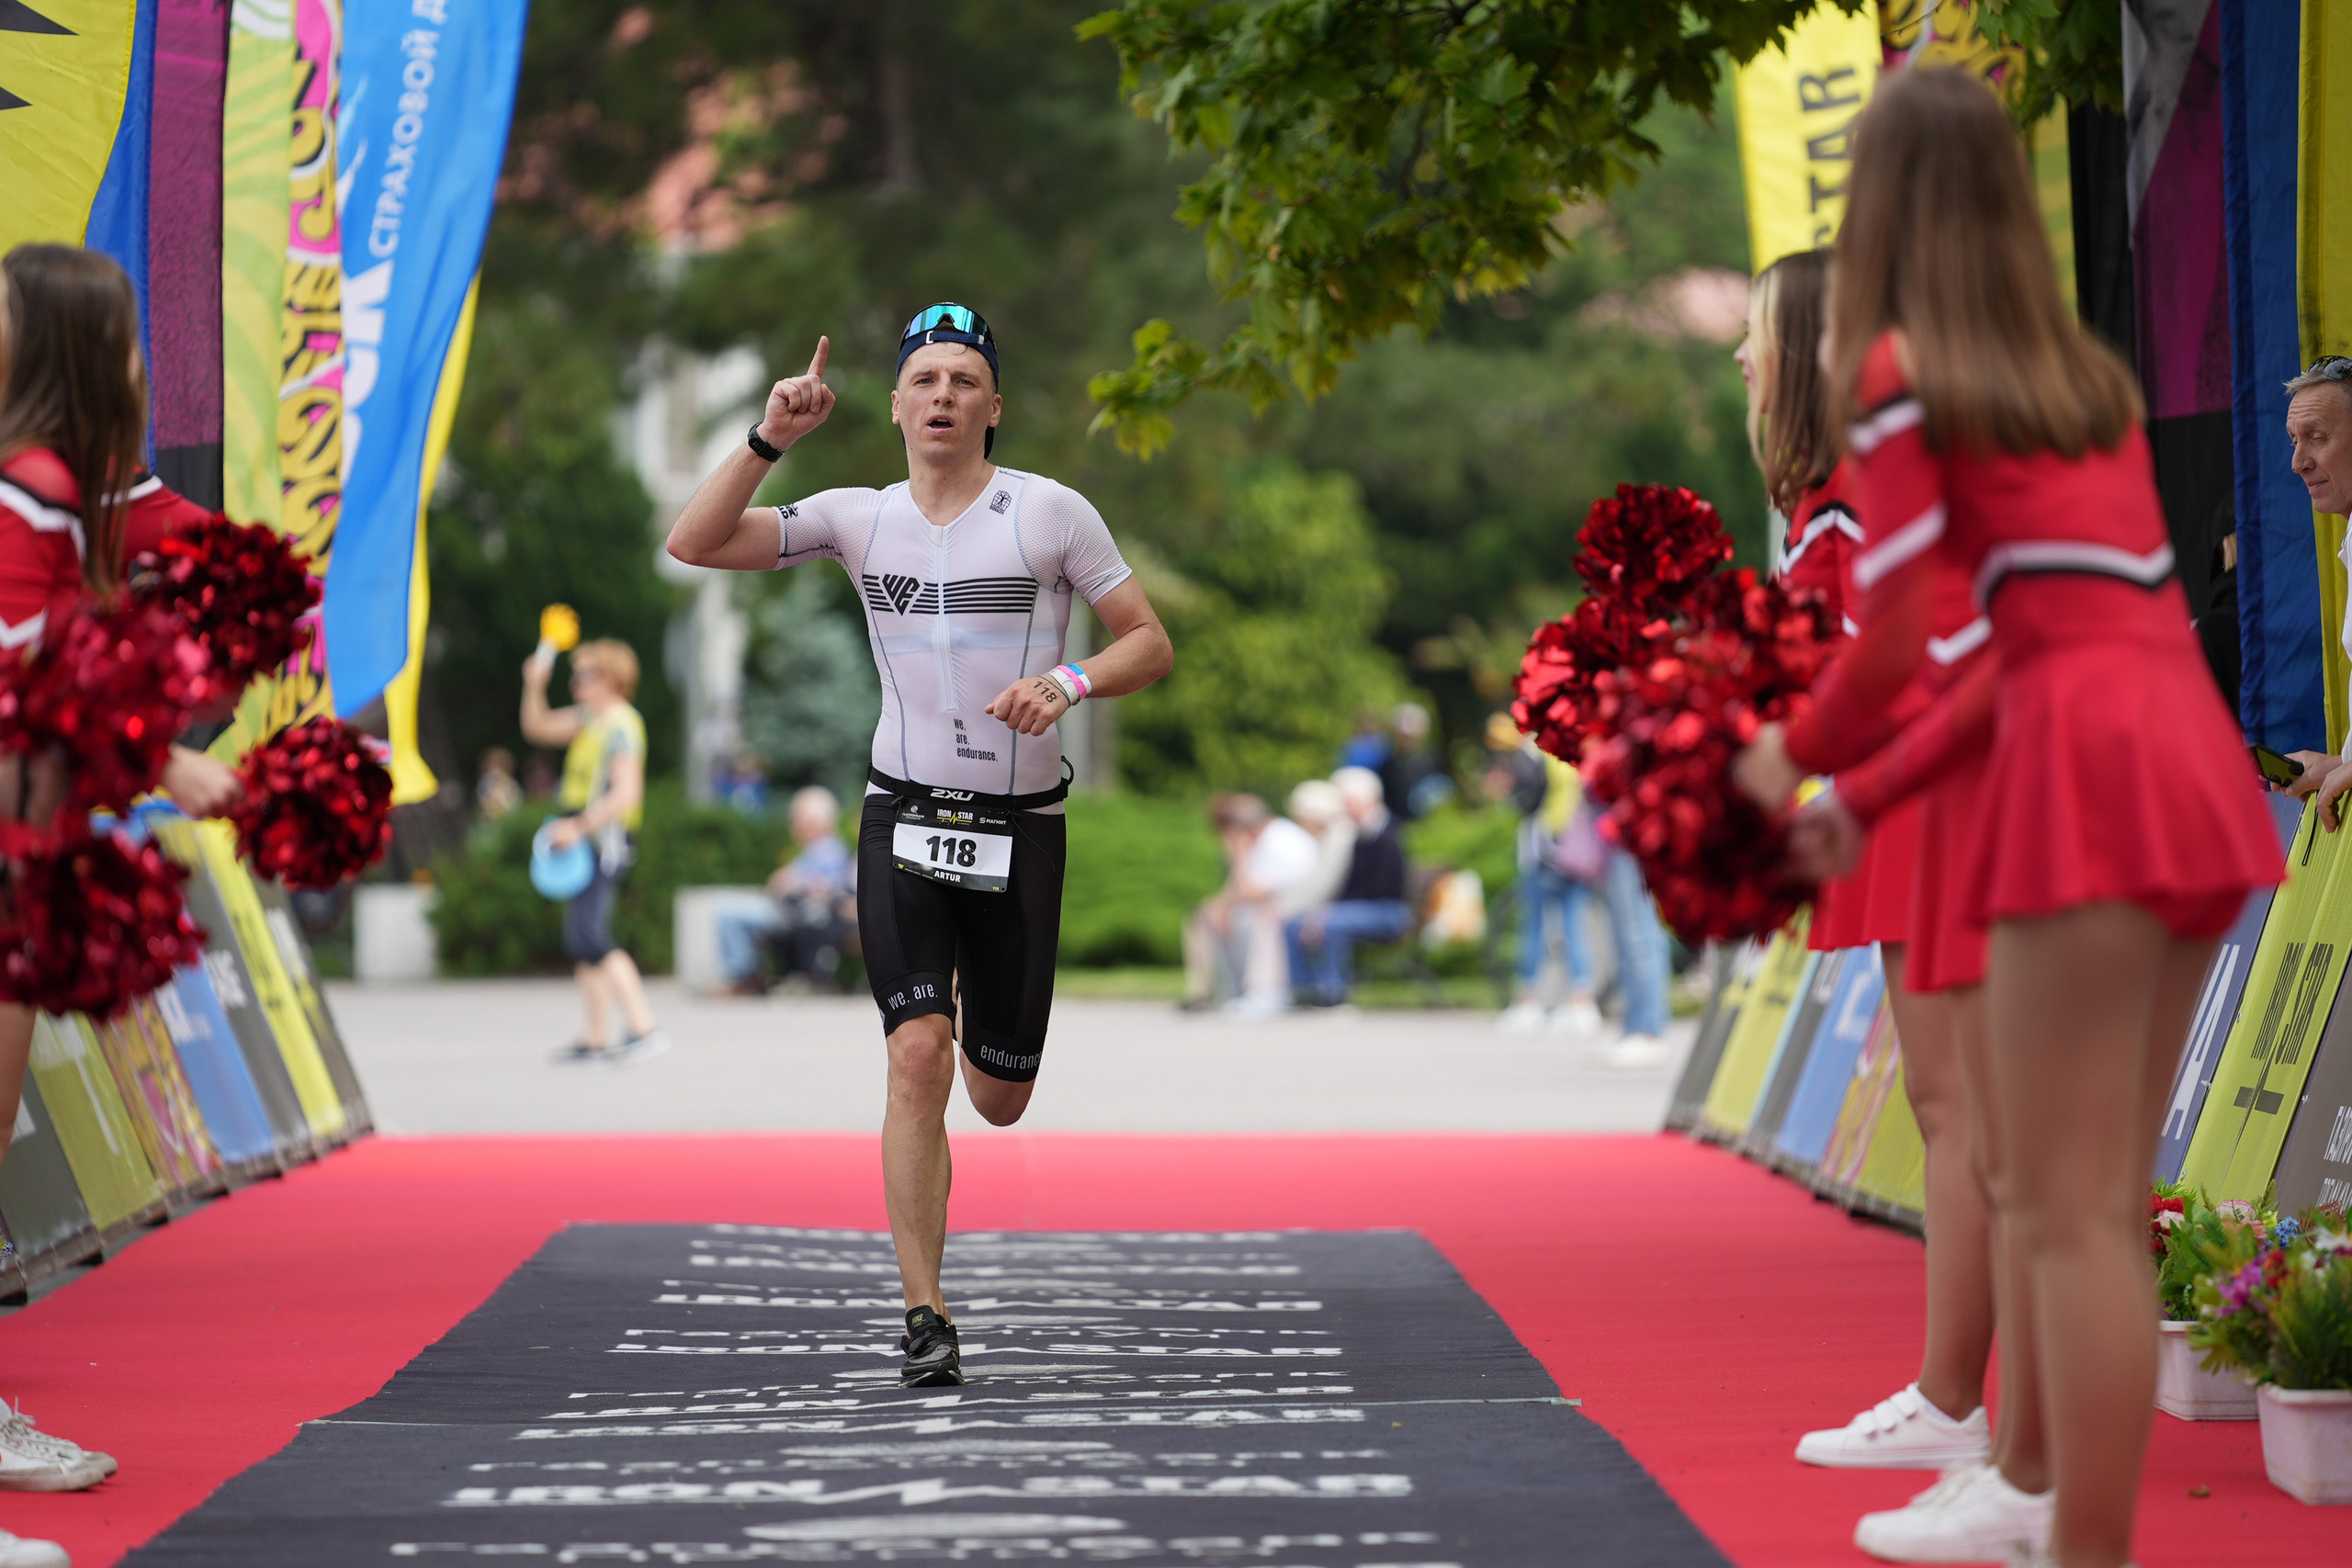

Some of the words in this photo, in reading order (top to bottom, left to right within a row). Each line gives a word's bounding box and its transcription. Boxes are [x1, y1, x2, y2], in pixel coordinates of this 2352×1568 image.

[368, 28, 440, 258] СТРАХОВОЙ
[1034, 681, 1057, 703] 118
[956, 734, 970, 745] are.
[956, 747, 999, 761] endurance.
[930, 787, 975, 801] 2XU
[936, 808, 953, 818] IRON
[957, 811, 974, 820] STAR
[925, 835, 977, 868] 118
[933, 870, 961, 883] ARTUR
[888, 991, 910, 1010] we.
[912, 983, 938, 999] are.
[2275, 942, 2335, 1066] STAR
[1046, 1344, 1342, 1355] STAR
[550, 1399, 859, 1416] IRON
[1028, 1385, 1355, 1399] STAR
[1023, 1409, 1365, 1423] STAR
[450, 1479, 823, 1502] IRON
[1022, 1474, 1412, 1496] STAR
